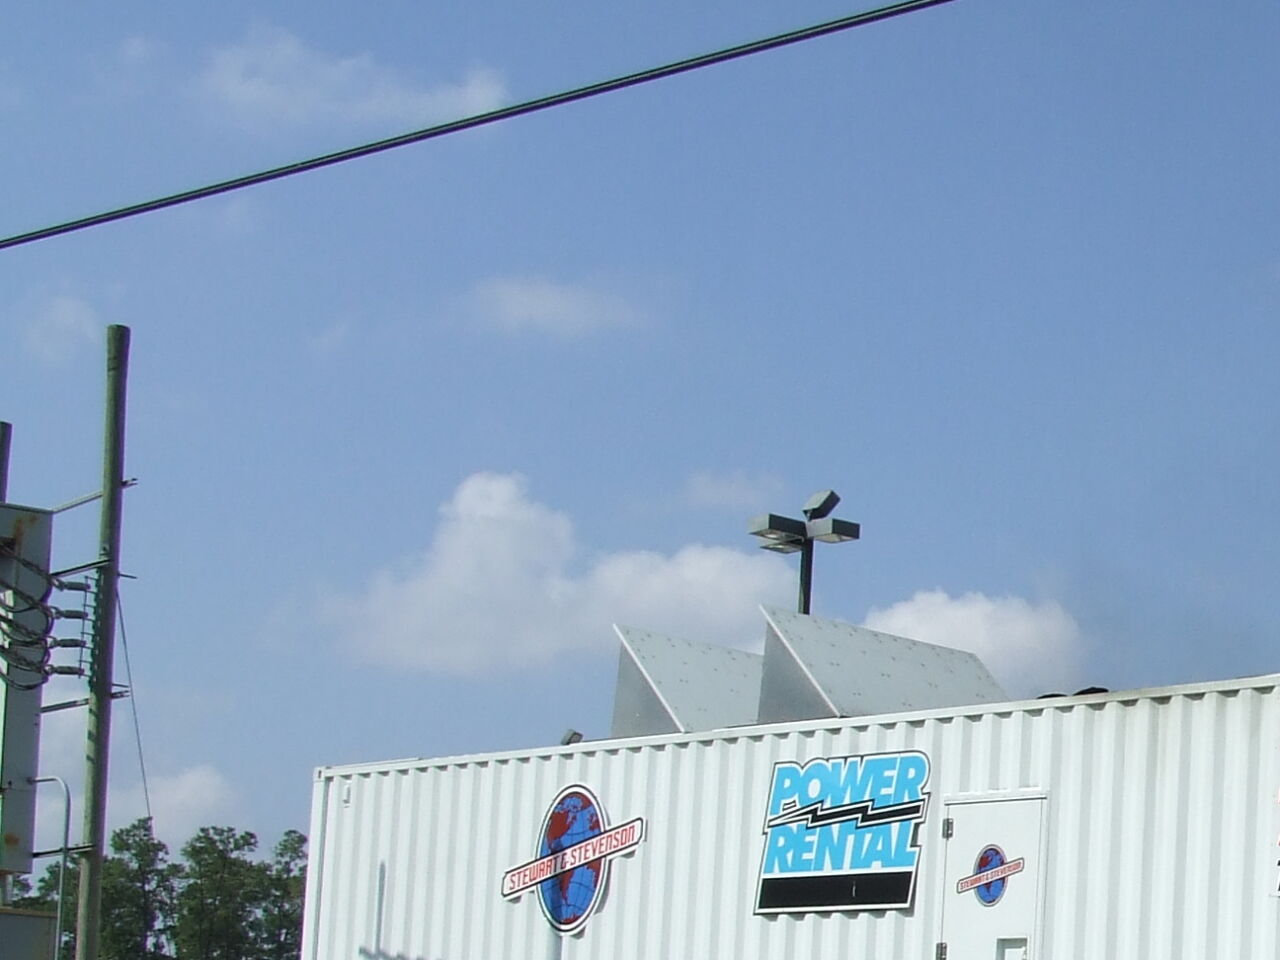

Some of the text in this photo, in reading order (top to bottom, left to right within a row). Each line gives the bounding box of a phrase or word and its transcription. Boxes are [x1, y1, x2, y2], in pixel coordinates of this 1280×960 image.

[769, 755, 927, 816] POWER
[509, 855, 561, 891] STEWART
[570, 825, 635, 867] STEVENSON
[763, 820, 917, 874] RENTAL
